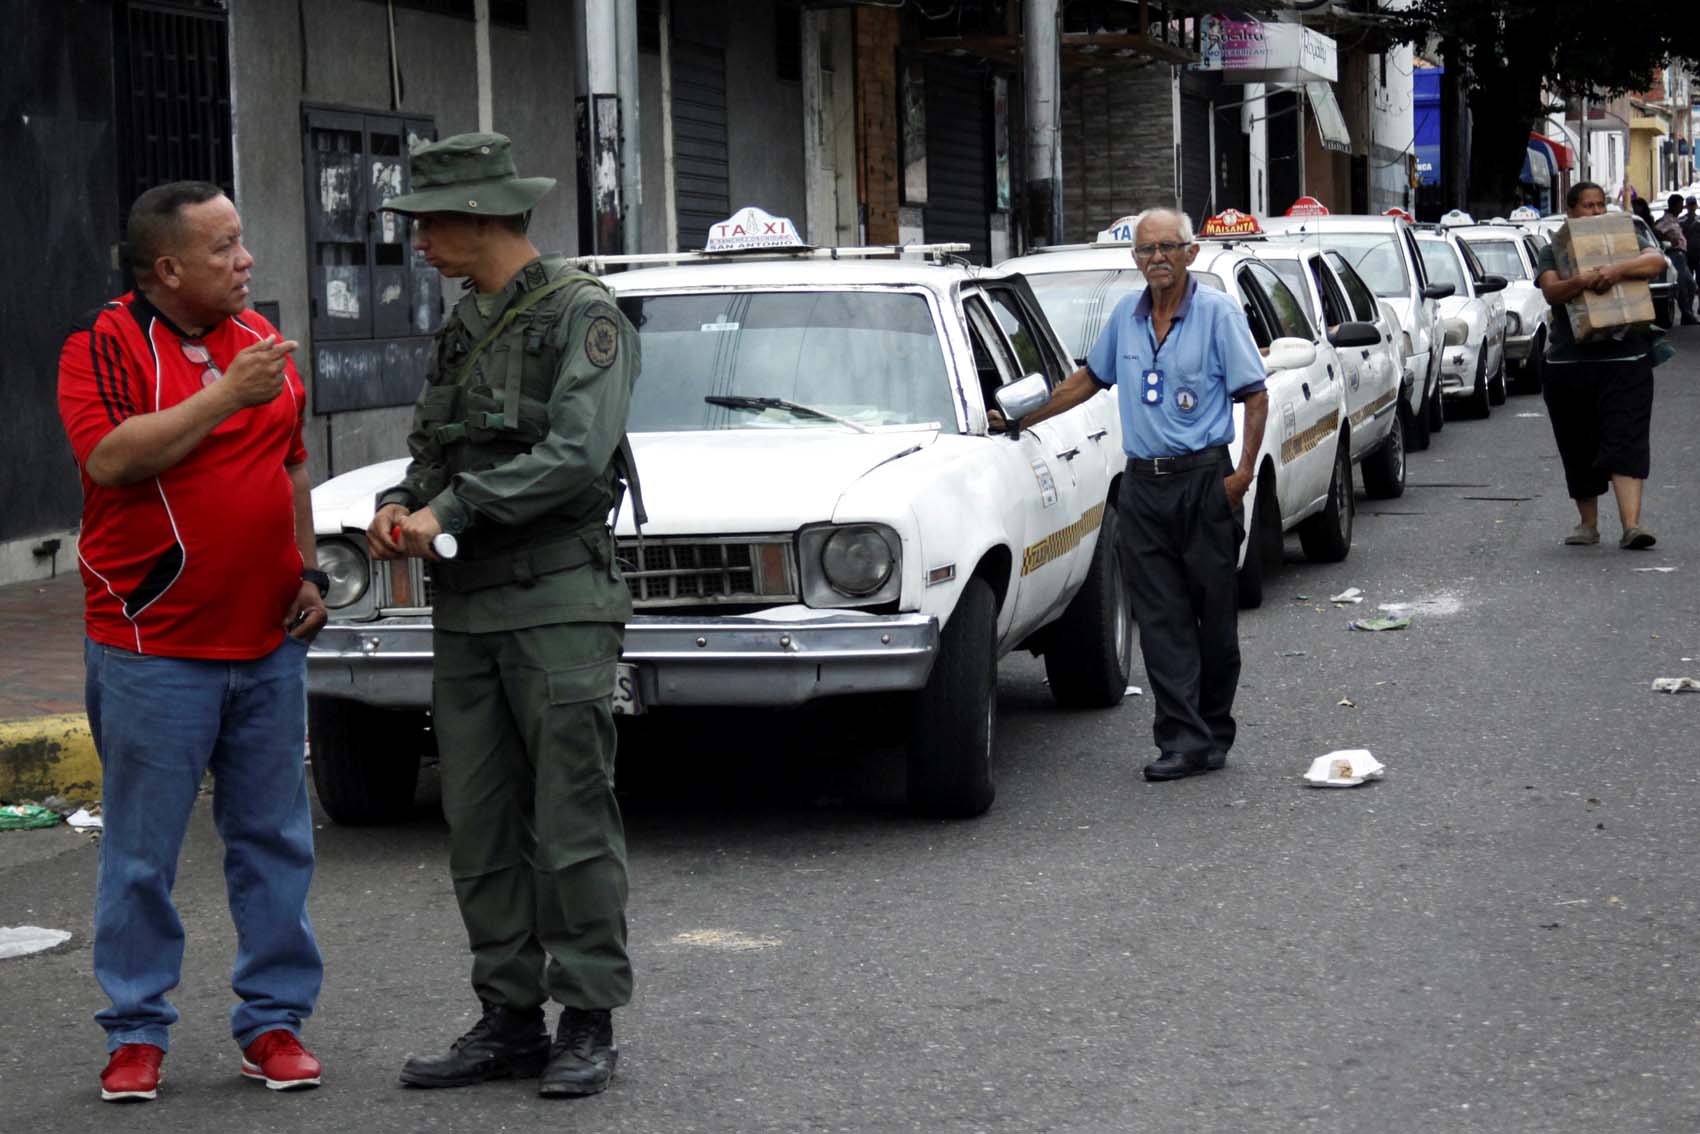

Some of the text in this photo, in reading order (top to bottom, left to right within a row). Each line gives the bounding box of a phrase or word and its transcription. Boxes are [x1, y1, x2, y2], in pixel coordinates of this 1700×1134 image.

[717, 222, 785, 237] TAXI
[1206, 222, 1255, 235] MAISANTA
[738, 240, 793, 249] ANTONIO
